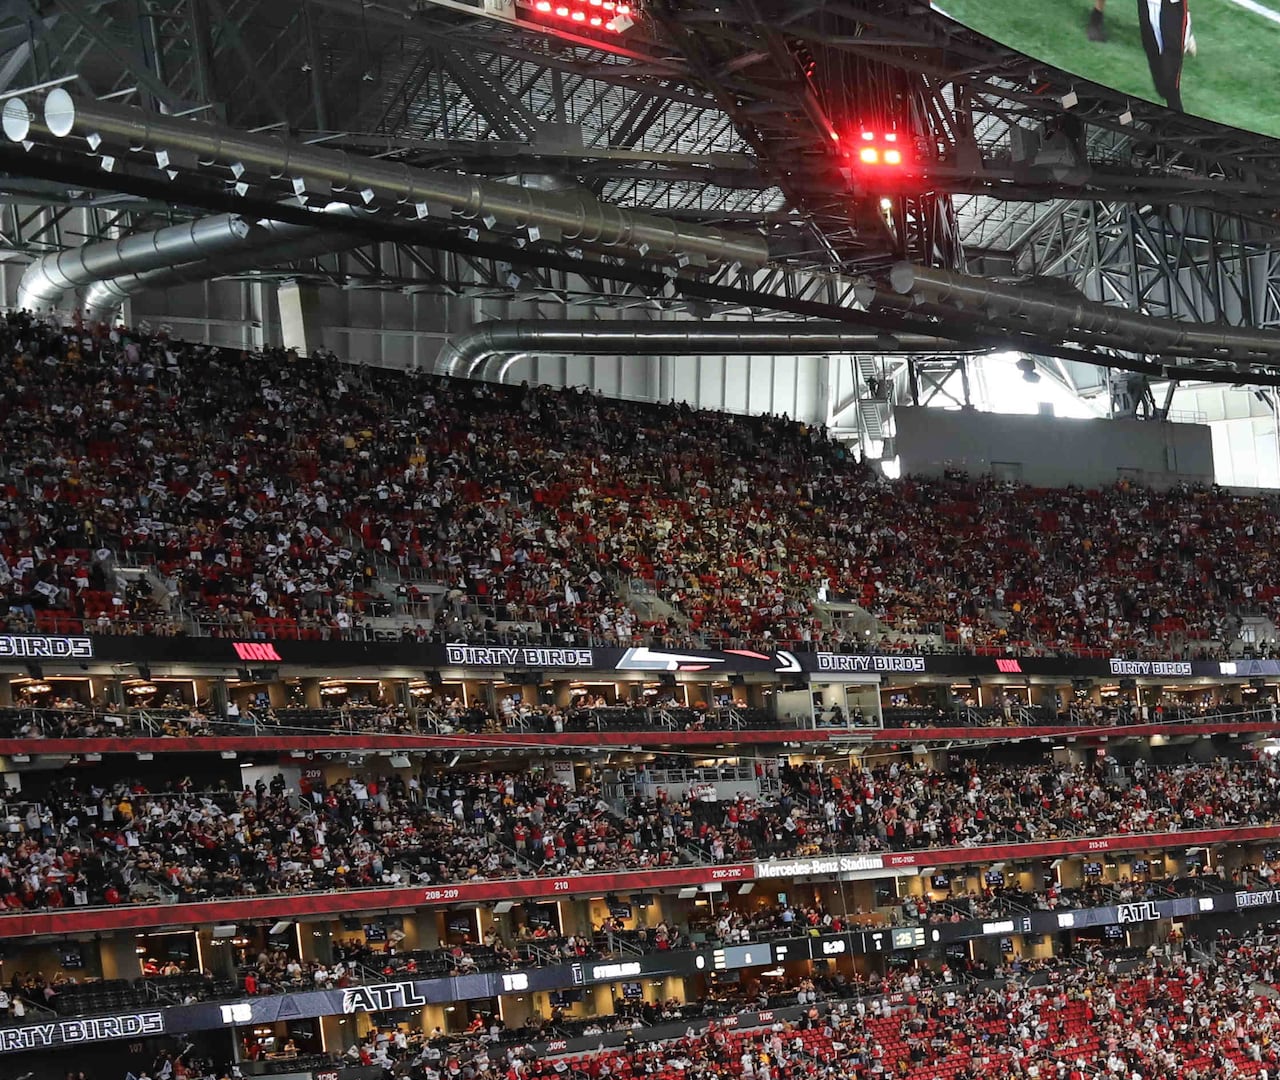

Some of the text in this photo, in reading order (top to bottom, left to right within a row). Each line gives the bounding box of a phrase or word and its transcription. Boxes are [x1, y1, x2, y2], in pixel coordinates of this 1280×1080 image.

[0, 635, 93, 658] BIRDS
[232, 643, 282, 661] KIRK
[446, 645, 592, 666] DIRTY BIRDS
[817, 652, 925, 672] DIRTY BIRDS
[996, 660, 1022, 672] KIRK
[1110, 660, 1192, 675] DIRTY BIRDS
[305, 769, 321, 778] 209
[759, 856, 883, 878] Mercedes-Benz Stadium
[426, 889, 459, 899] 208-209
[554, 882, 569, 890] 210
[1235, 890, 1273, 907] DIRTY
[1117, 902, 1160, 923] ATL
[343, 981, 426, 1014] ATL
[62, 1012, 163, 1043] BIRDS
